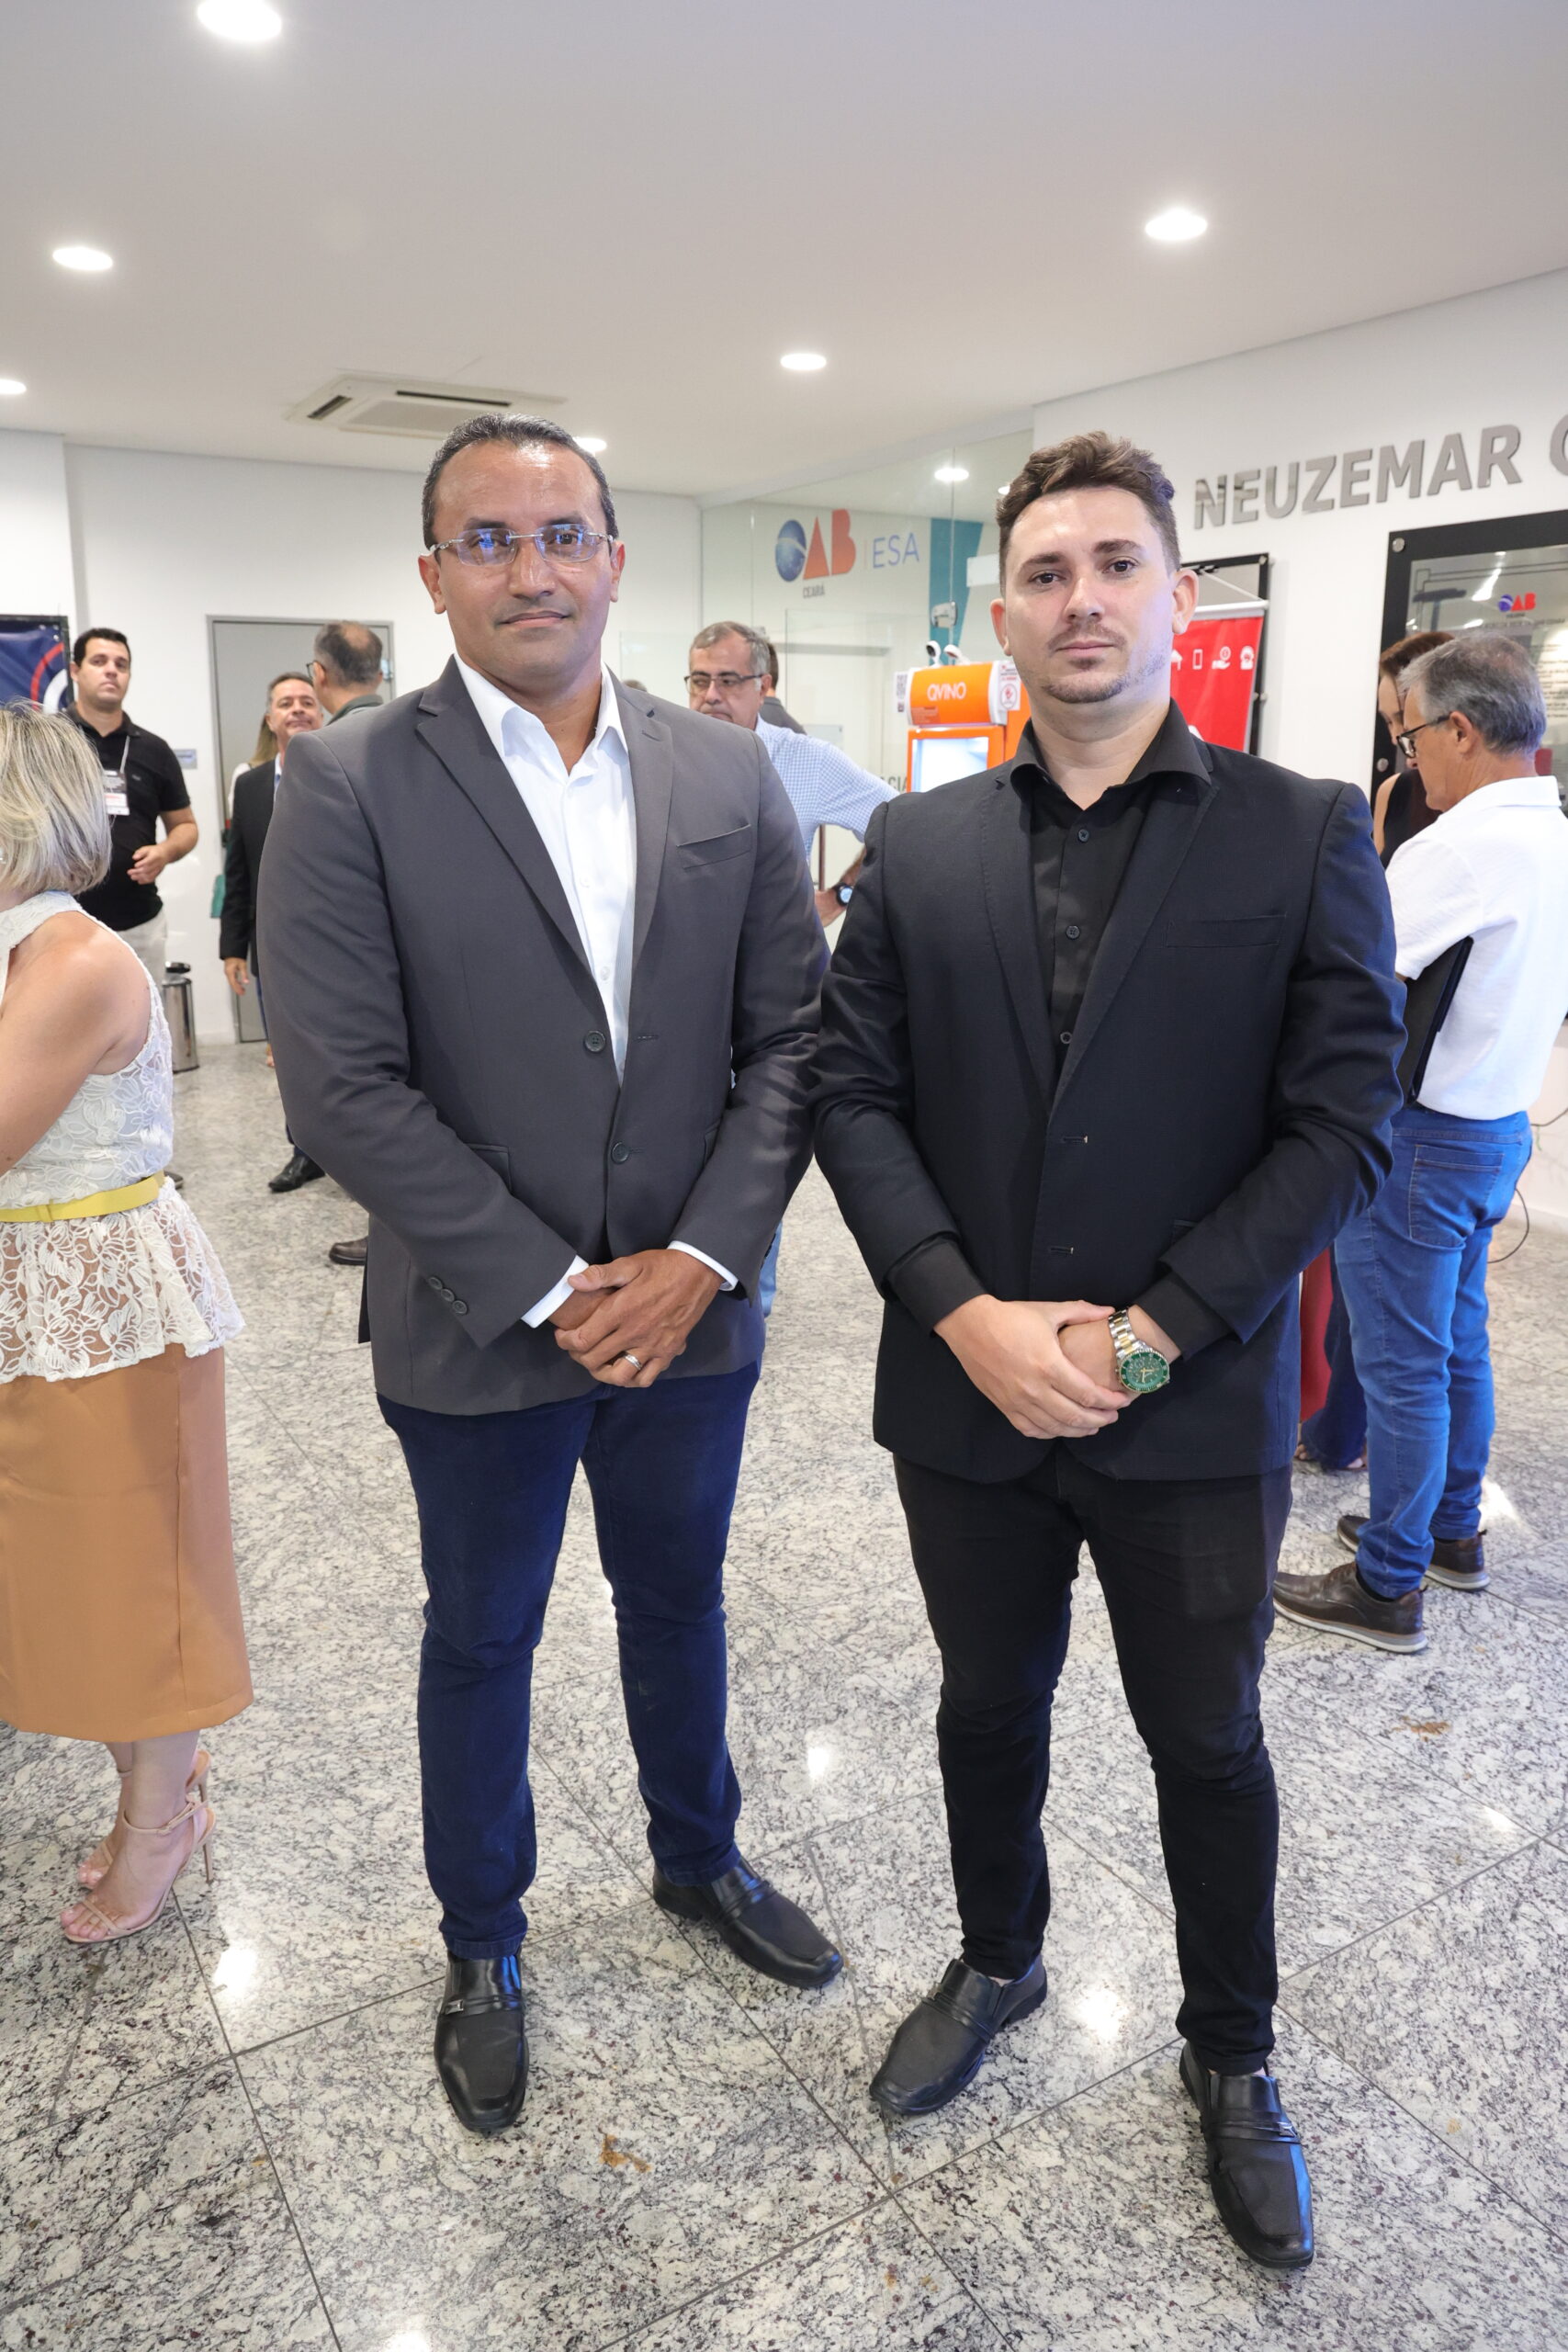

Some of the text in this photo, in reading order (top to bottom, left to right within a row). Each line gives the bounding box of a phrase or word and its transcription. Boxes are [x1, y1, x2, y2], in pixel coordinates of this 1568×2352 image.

[1194, 424, 1523, 530] NEUZEMAR
[774, 508, 919, 582] OAB ESA
[1498, 593, 1537, 613] OAB
